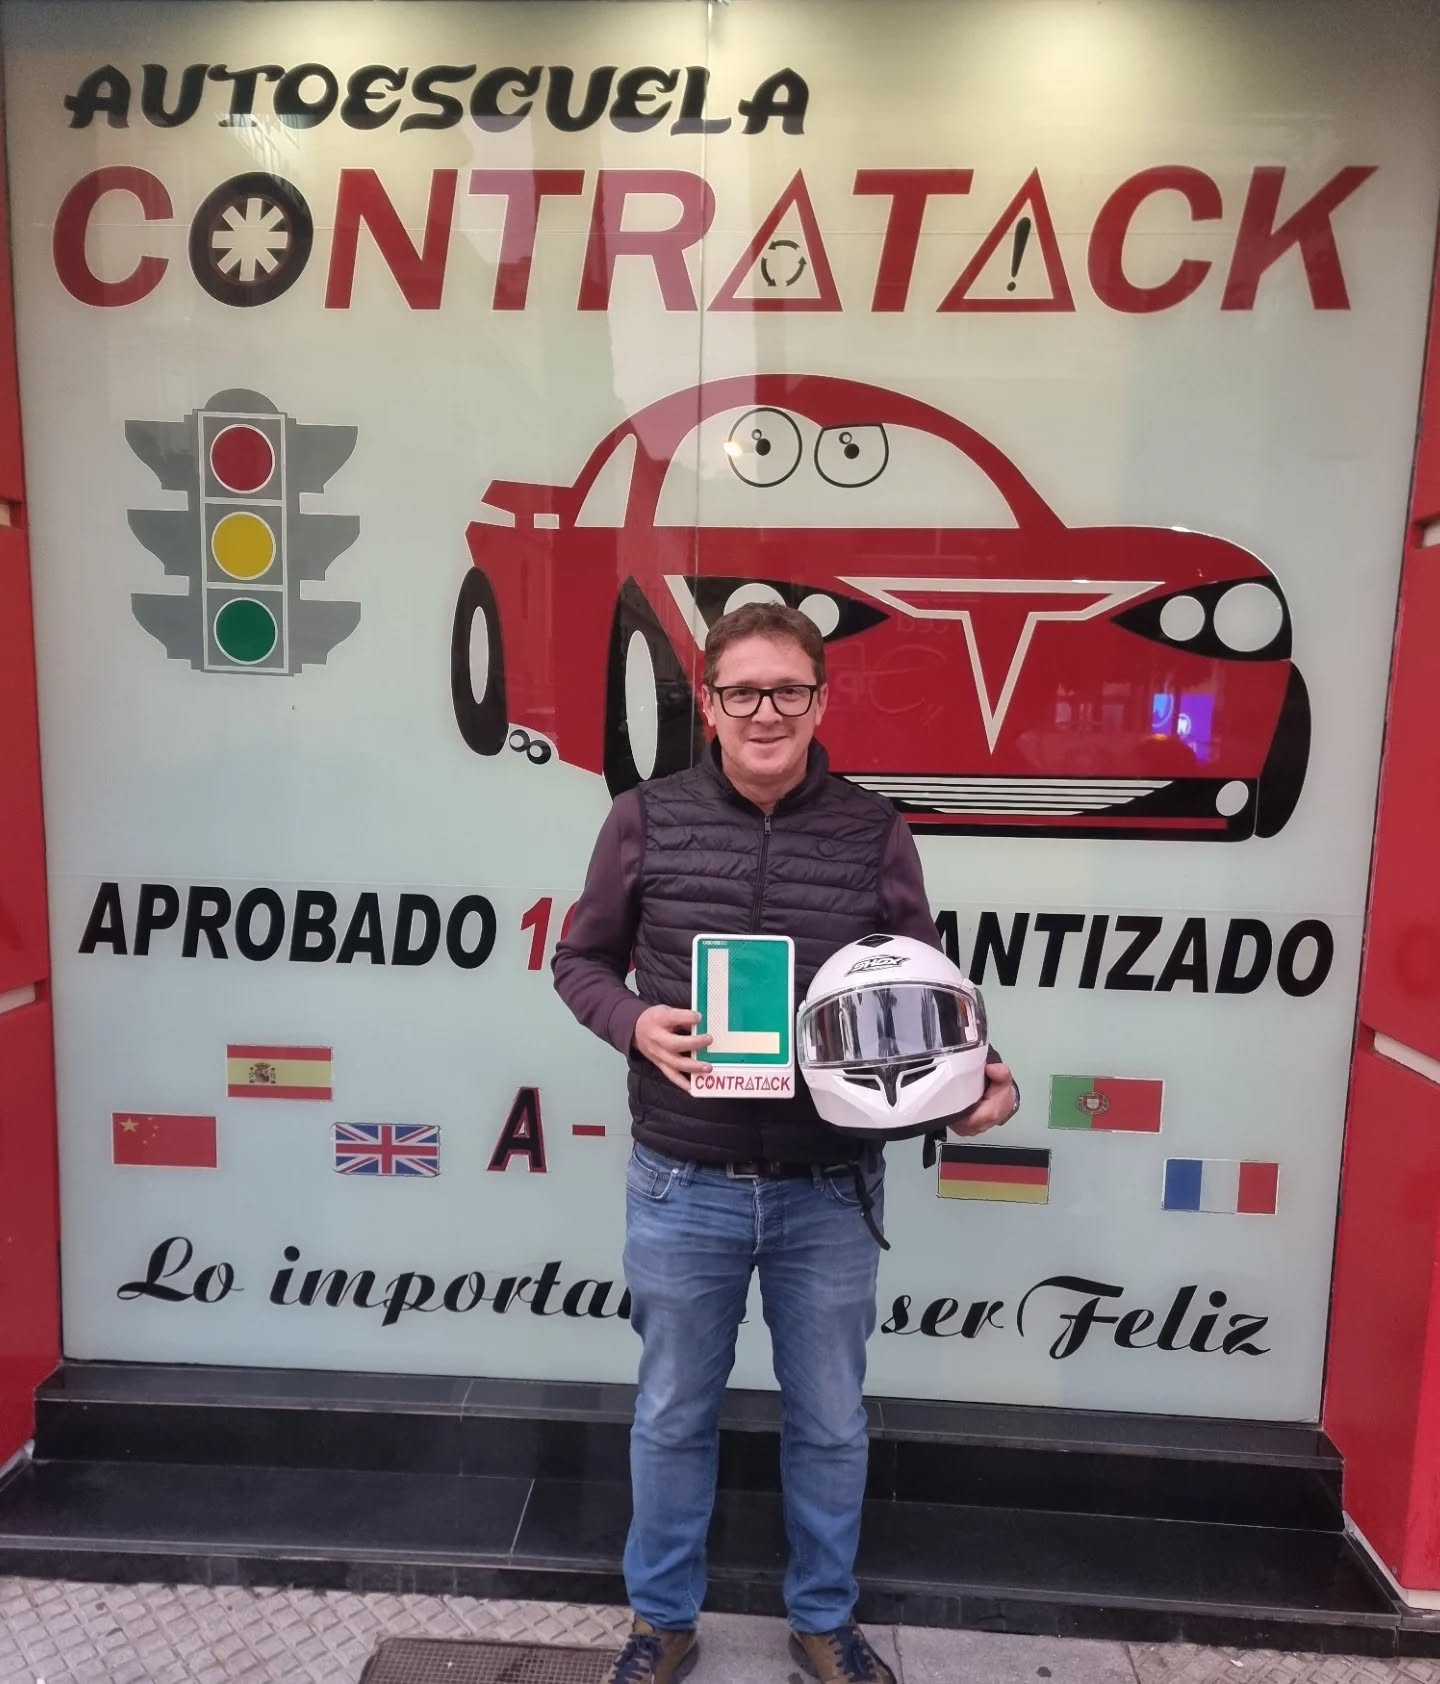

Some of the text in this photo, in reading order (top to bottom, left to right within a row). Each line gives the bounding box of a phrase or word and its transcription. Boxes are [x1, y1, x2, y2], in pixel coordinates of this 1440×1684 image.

[65, 61, 811, 136] AUTOESCUELA
[51, 163, 1380, 314] CONTRATACK
[78, 881, 498, 970] APROBADO
[933, 909, 1335, 998] ANTIZADO
[707, 947, 781, 1055] L
[695, 1074, 791, 1091] CONTRATACK
[116, 1235, 244, 1304] Lo
[881, 1293, 1005, 1339] ser
[1016, 1274, 1272, 1361] Feliz
